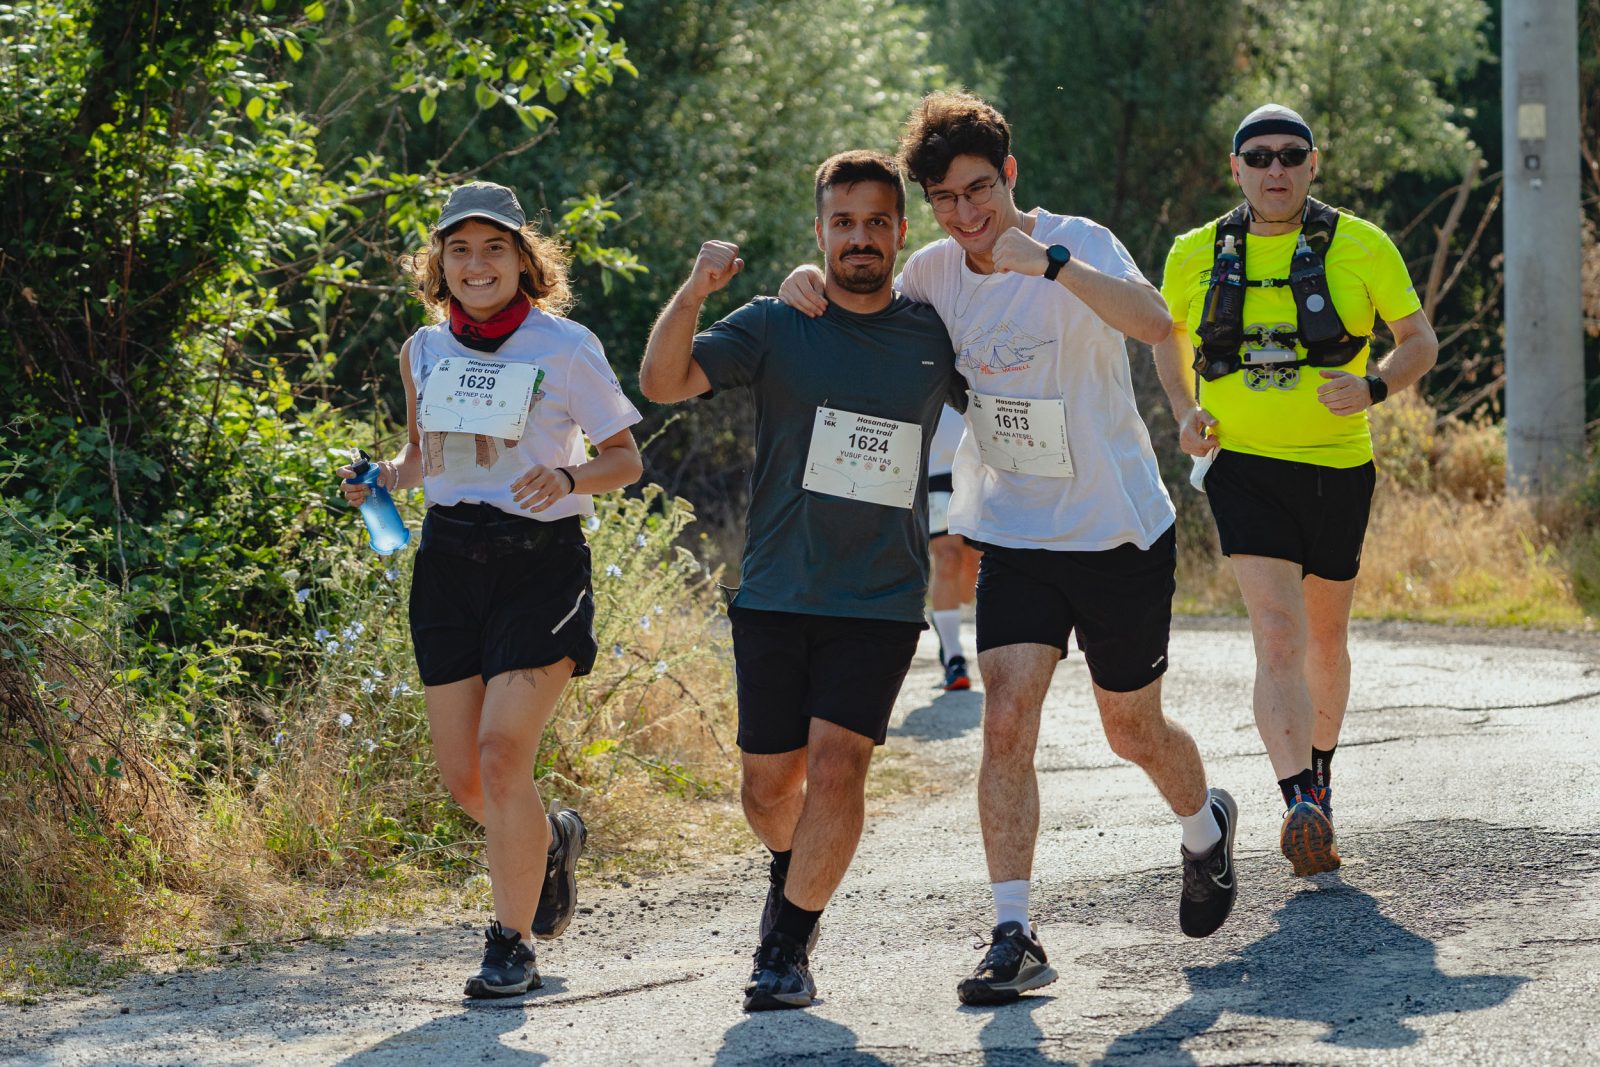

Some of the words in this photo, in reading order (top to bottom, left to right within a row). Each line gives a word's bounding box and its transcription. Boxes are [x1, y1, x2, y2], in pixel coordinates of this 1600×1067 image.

[458, 374, 496, 390] 1629
[454, 390, 478, 398] ZEYNEP
[823, 419, 837, 427] 16K
[857, 417, 899, 430] Hasandağı
[995, 414, 1030, 430] 1613
[855, 426, 875, 434] ultra
[875, 428, 893, 437] trail
[848, 433, 889, 454] 1624
[840, 450, 862, 459] YUSUF
[862, 455, 877, 463] CAN
[878, 457, 892, 466] TAŞ
